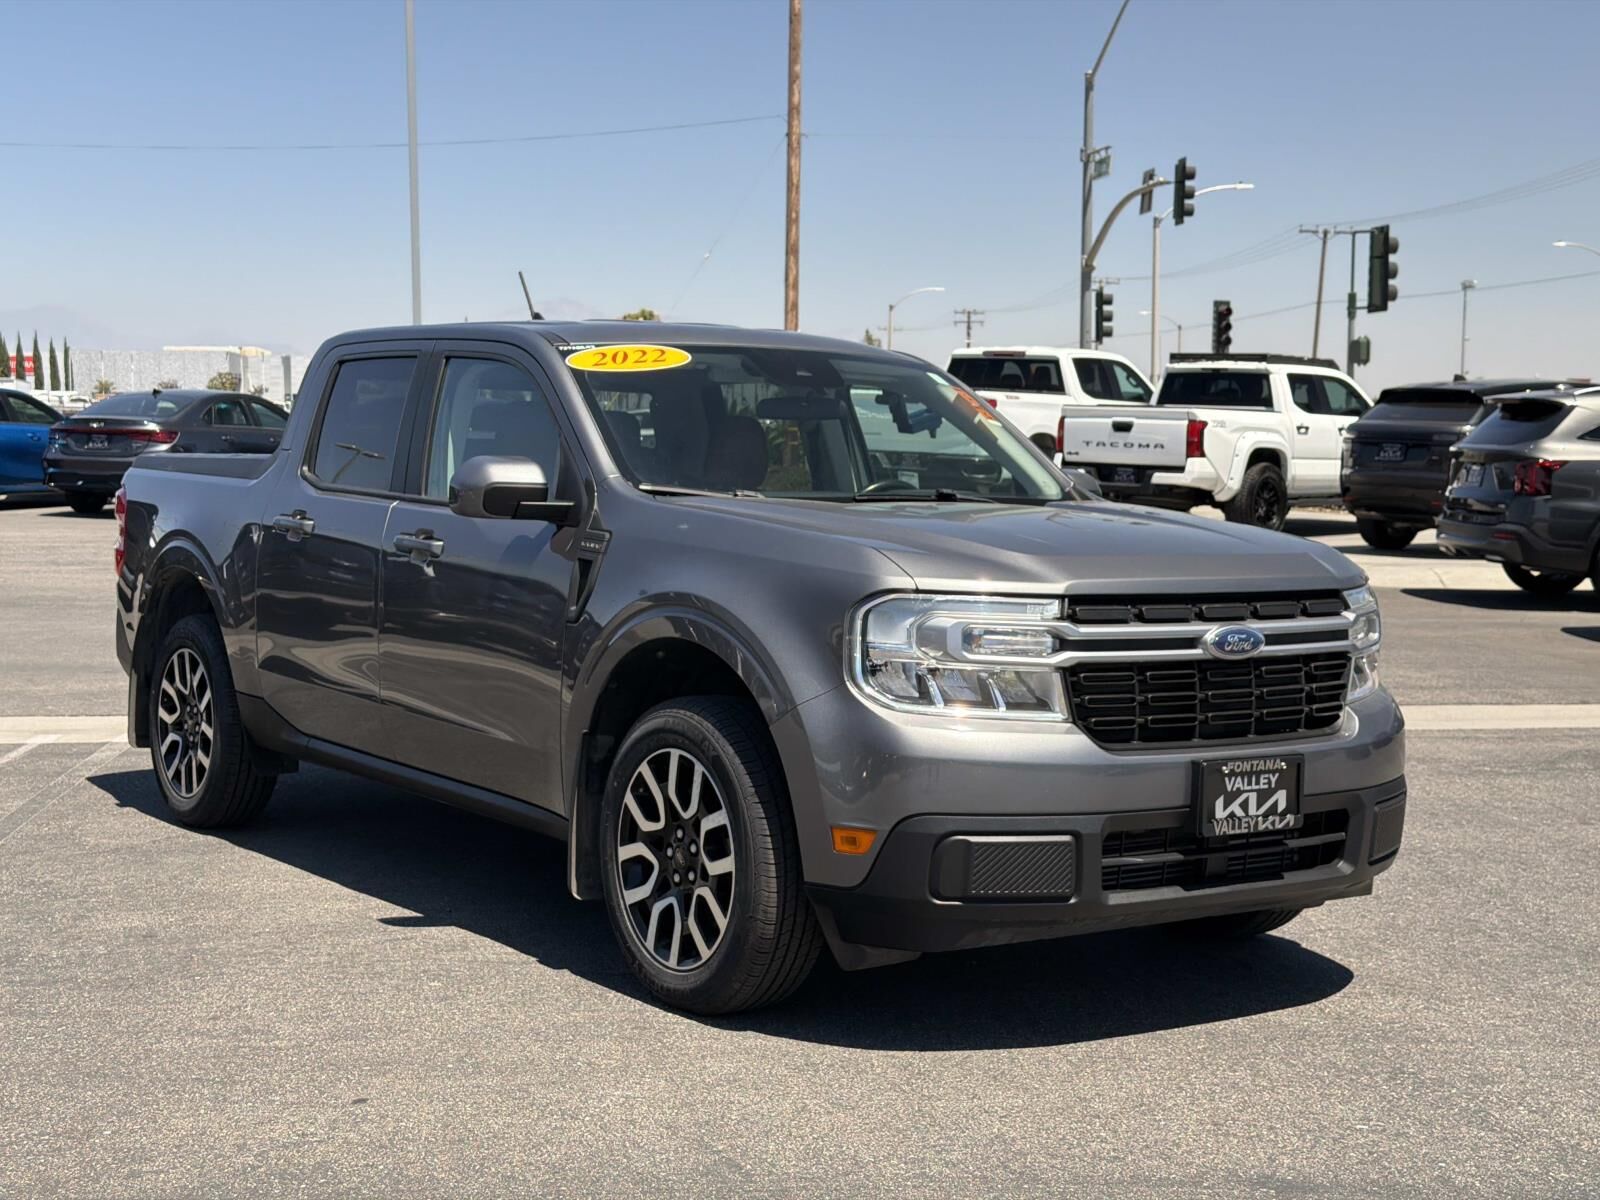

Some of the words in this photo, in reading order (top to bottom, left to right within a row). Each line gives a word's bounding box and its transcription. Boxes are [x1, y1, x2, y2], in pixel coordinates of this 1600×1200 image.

[592, 349, 667, 366] 2022
[1082, 440, 1166, 449] TACOMA
[1224, 633, 1255, 651] Ford
[1227, 759, 1281, 773] FONTANA
[1225, 773, 1280, 792] VALLEY
[1215, 789, 1287, 819] KIA
[1212, 817, 1256, 836] VALLEY
[1257, 813, 1295, 831] KIA
